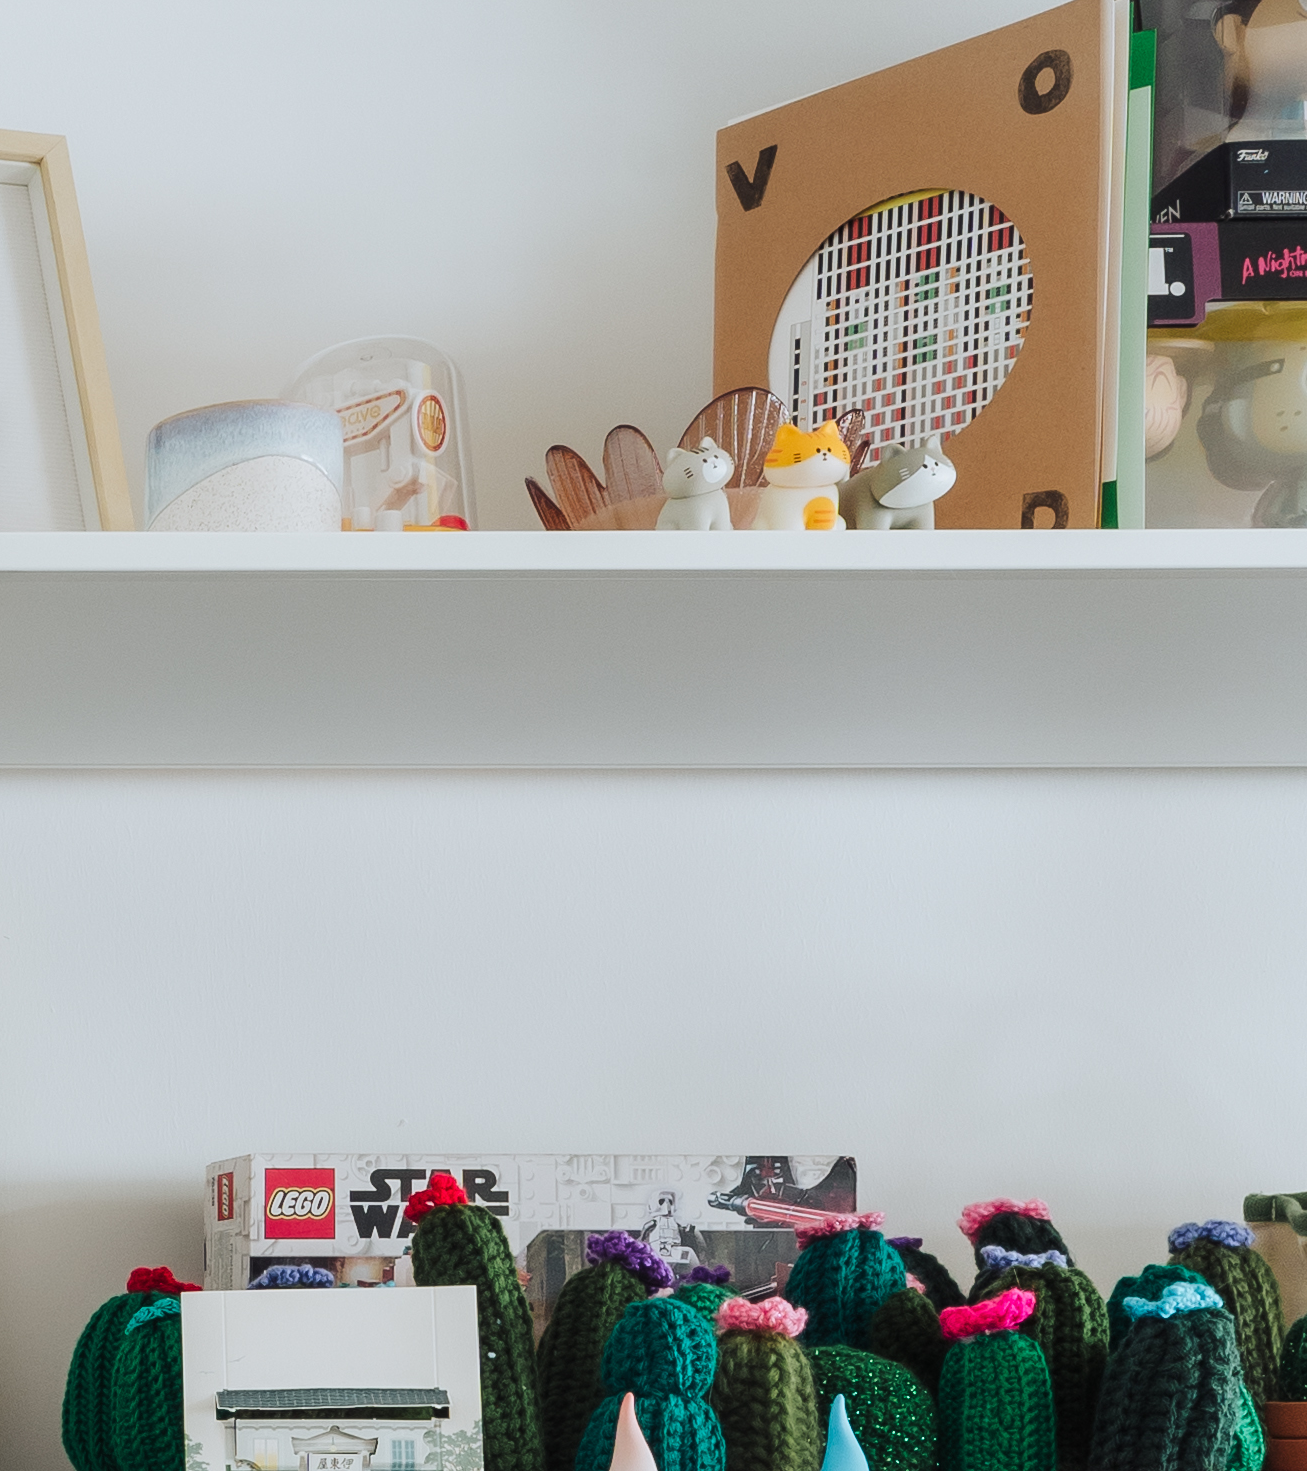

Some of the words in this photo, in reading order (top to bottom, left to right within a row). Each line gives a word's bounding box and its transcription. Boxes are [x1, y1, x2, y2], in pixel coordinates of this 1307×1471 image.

[1018, 49, 1073, 115] O
[1237, 149, 1269, 162] Funko
[726, 145, 778, 212] V
[1242, 258, 1254, 285] A
[268, 1188, 333, 1218] LEGO
